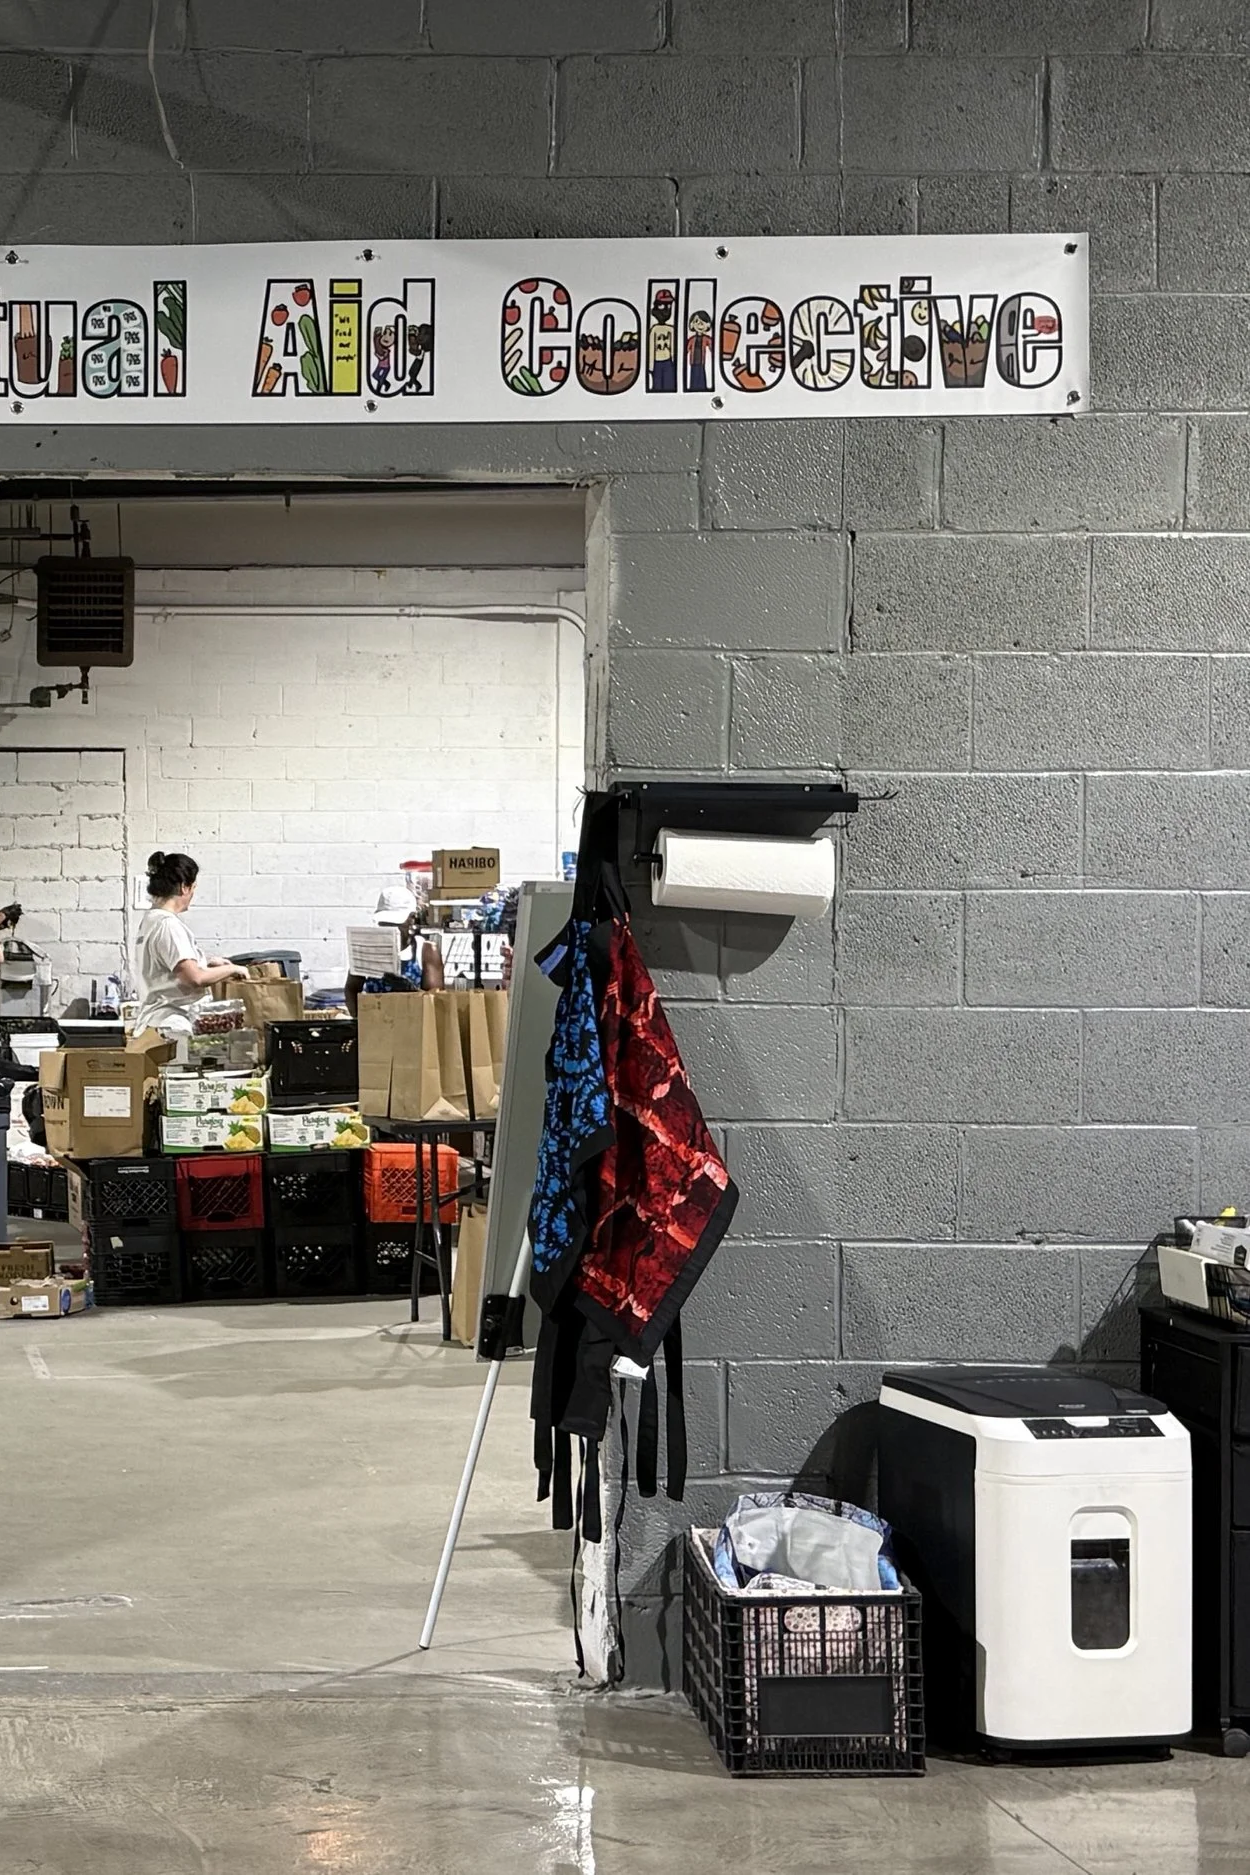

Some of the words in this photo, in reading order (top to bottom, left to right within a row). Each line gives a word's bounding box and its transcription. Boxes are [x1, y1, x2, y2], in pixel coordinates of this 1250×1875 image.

[251, 277, 436, 397] Aid
[500, 276, 1064, 397] Collective
[449, 856, 496, 869] HARIBO
